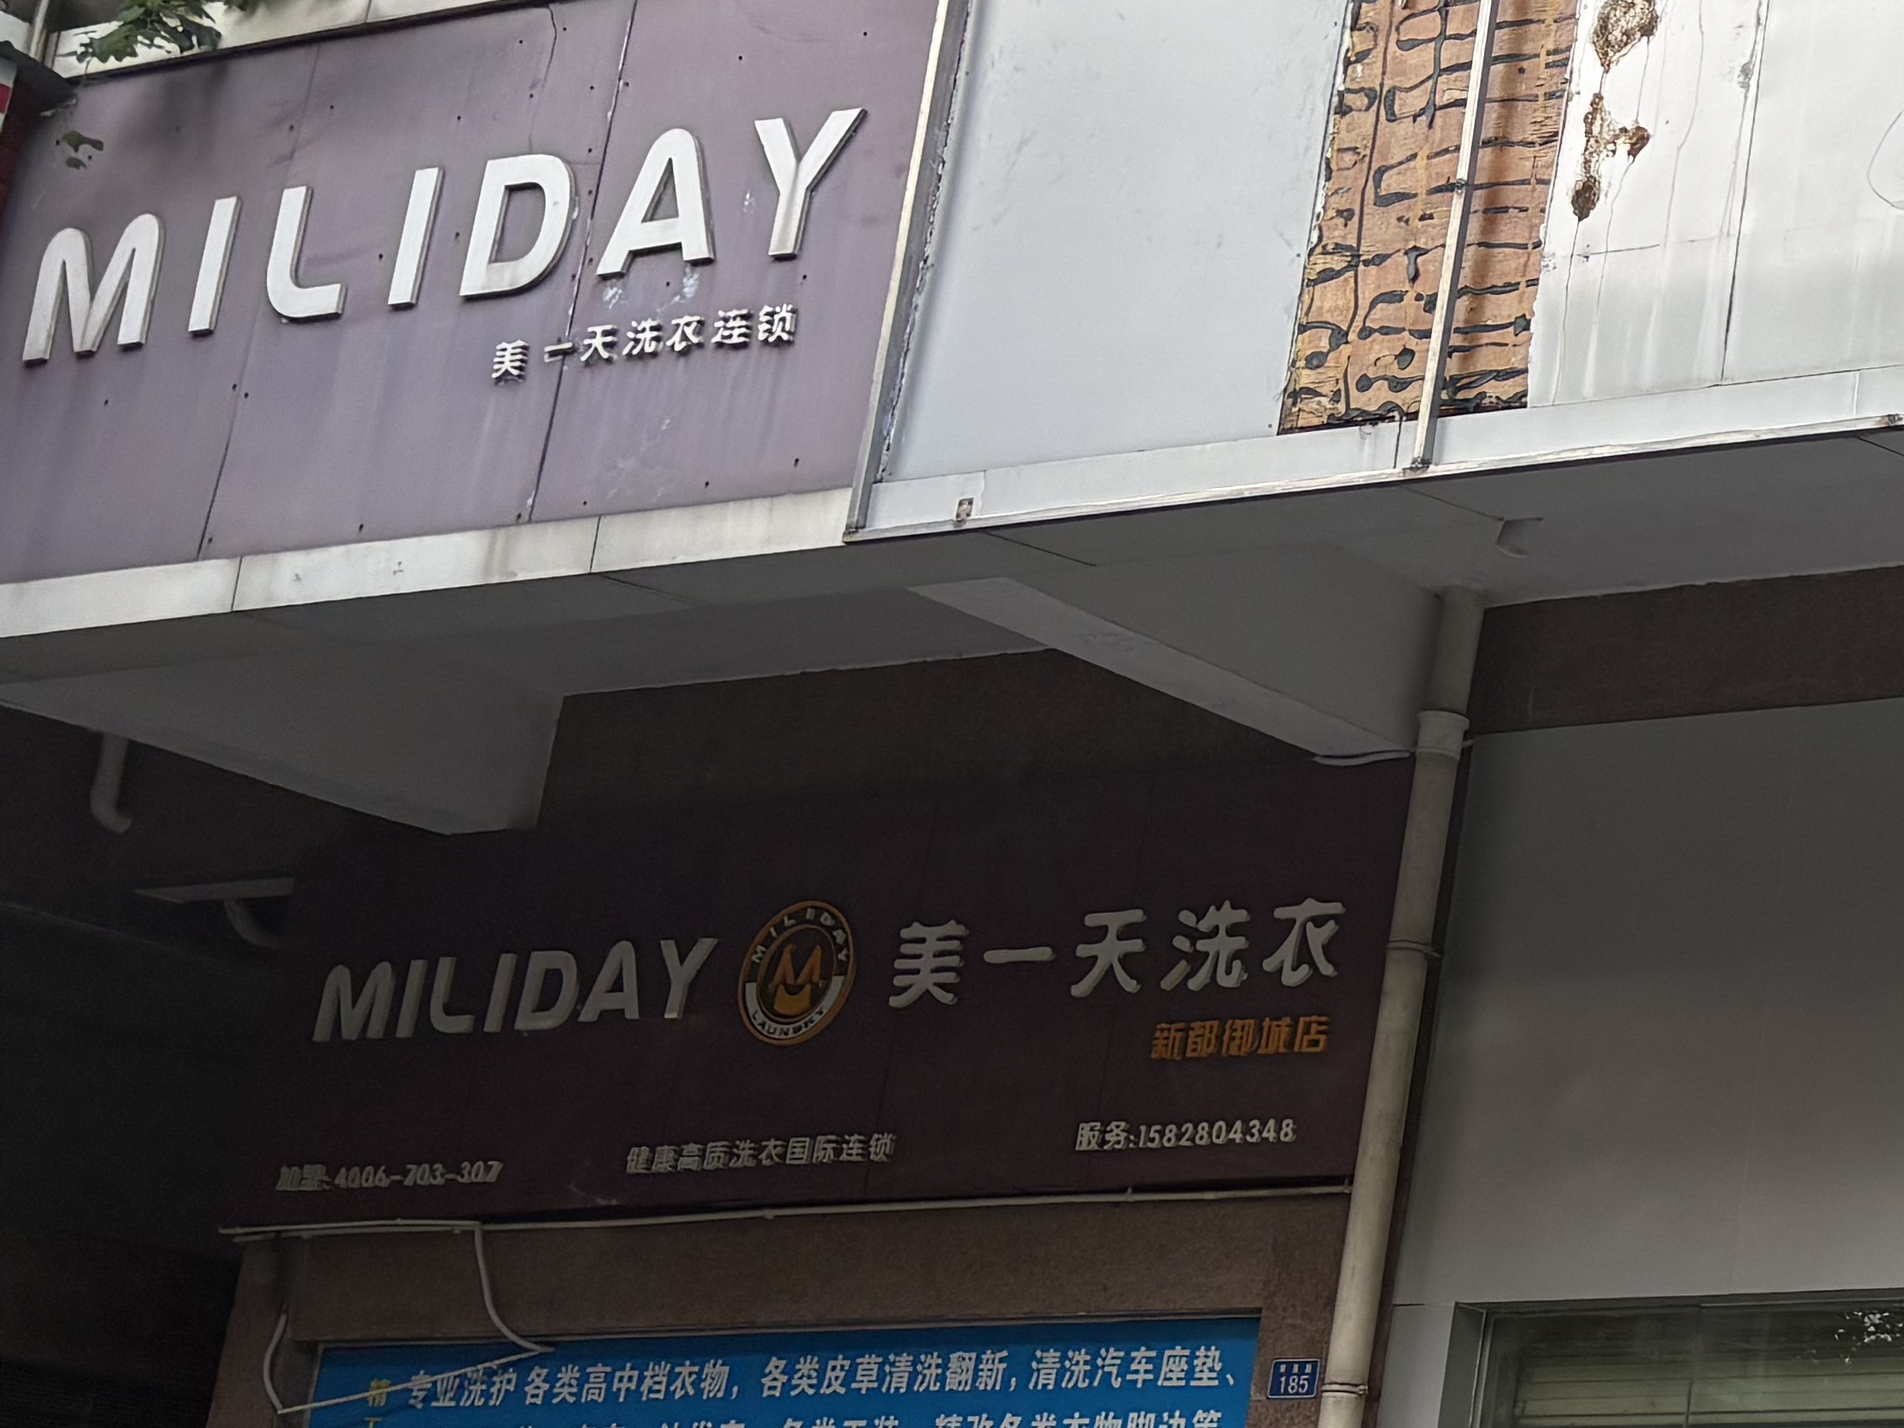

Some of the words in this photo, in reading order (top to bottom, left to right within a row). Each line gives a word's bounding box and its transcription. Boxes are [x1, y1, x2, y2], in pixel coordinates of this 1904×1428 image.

[22, 108, 869, 366] MILIDAY
[491, 303, 796, 382] 美一天洗衣连锁
[312, 934, 720, 1042] MILIDAY
[888, 896, 1348, 1008] 美一天洗衣
[1151, 1015, 1331, 1060] 新都御城店
[626, 1132, 897, 1174] 健康高质洗衣国际连锁
[1280, 1375, 1309, 1394] 185
